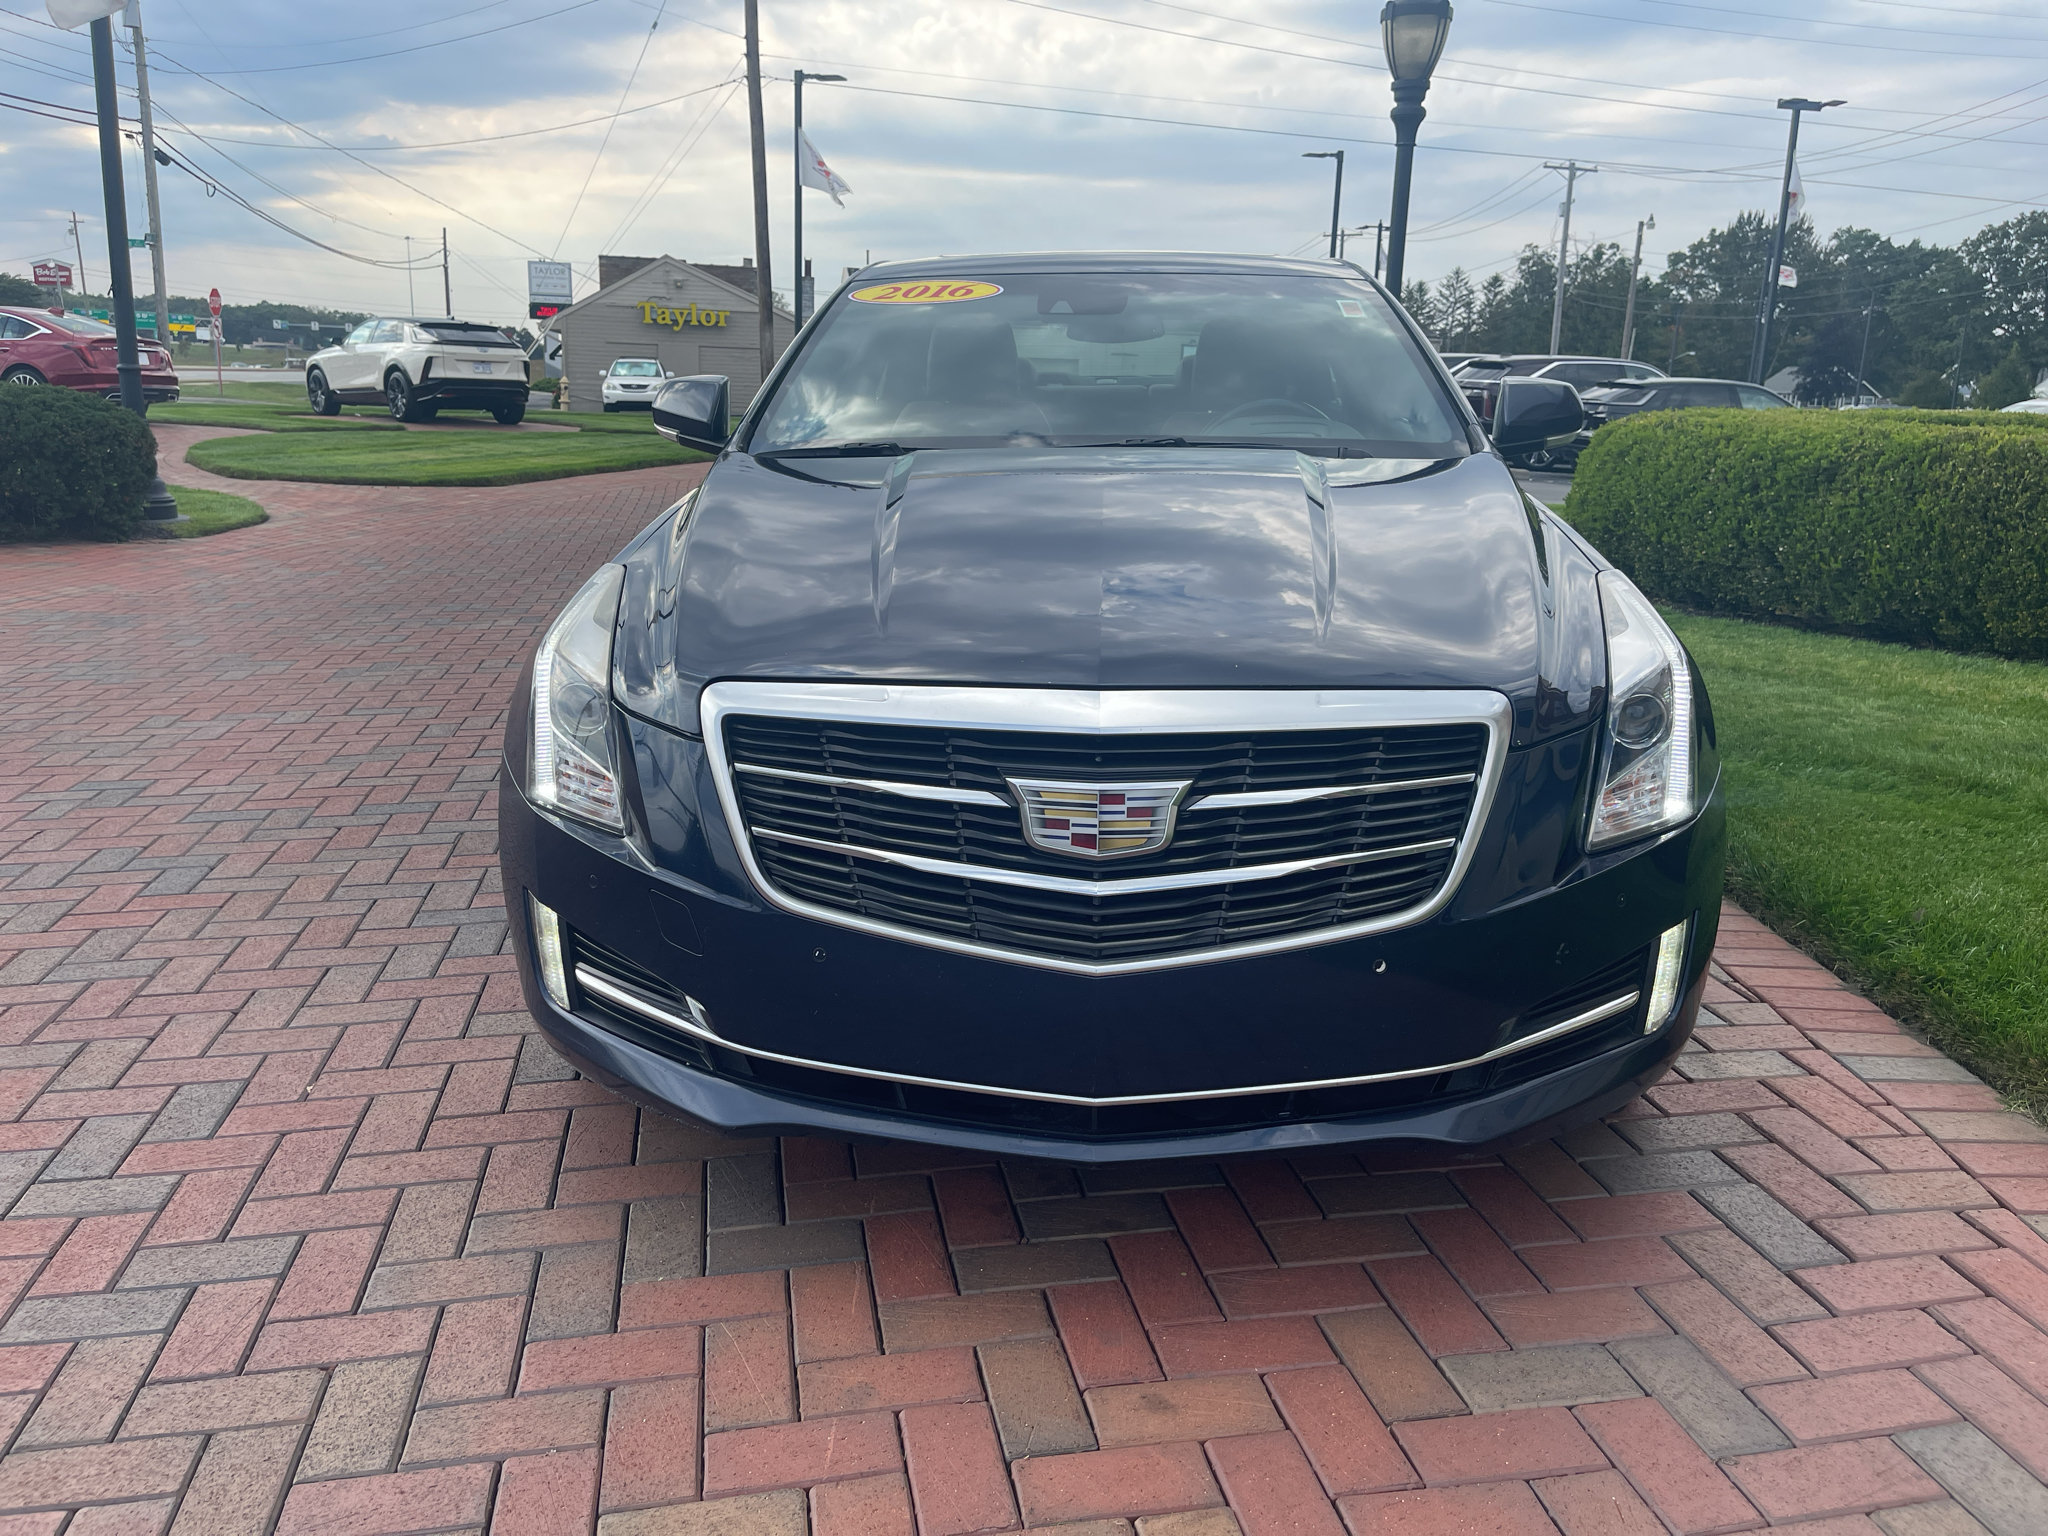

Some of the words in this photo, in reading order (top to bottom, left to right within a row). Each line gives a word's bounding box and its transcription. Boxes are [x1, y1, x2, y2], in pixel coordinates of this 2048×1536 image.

[534, 266, 567, 276] TAYLOR
[872, 284, 975, 300] 2016
[637, 301, 730, 331] Taylor
